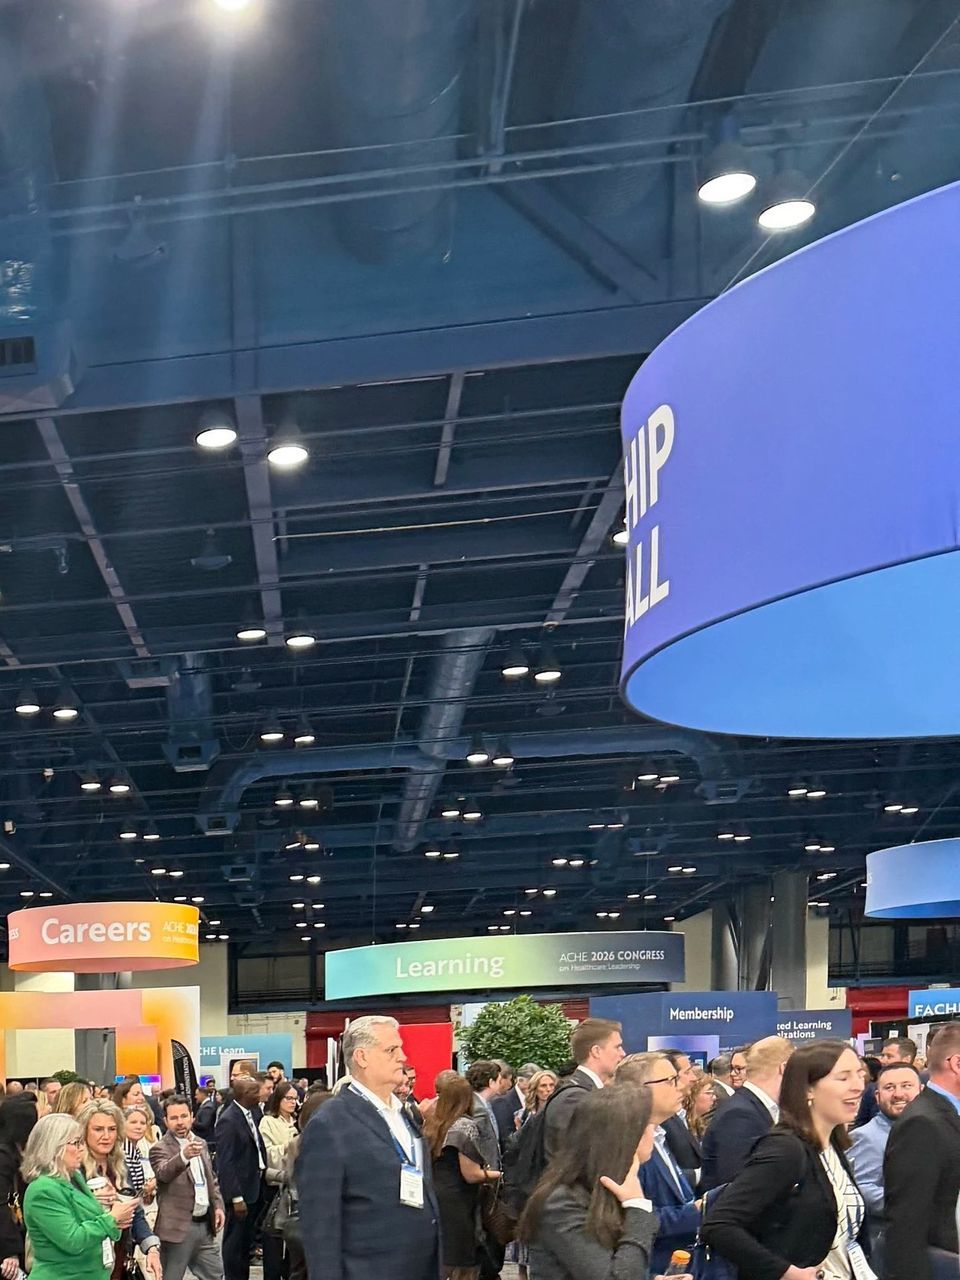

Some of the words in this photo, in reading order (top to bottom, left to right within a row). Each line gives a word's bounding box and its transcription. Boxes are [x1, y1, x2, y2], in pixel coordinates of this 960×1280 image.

[41, 917, 151, 945] Careers
[559, 952, 587, 963] ACHE
[591, 951, 615, 961] 2026
[617, 950, 665, 960] CONGRESS
[396, 952, 505, 978] Learning
[670, 1007, 734, 1023] Membership
[793, 1020, 832, 1030] Learning
[219, 1046, 245, 1054] Learn
